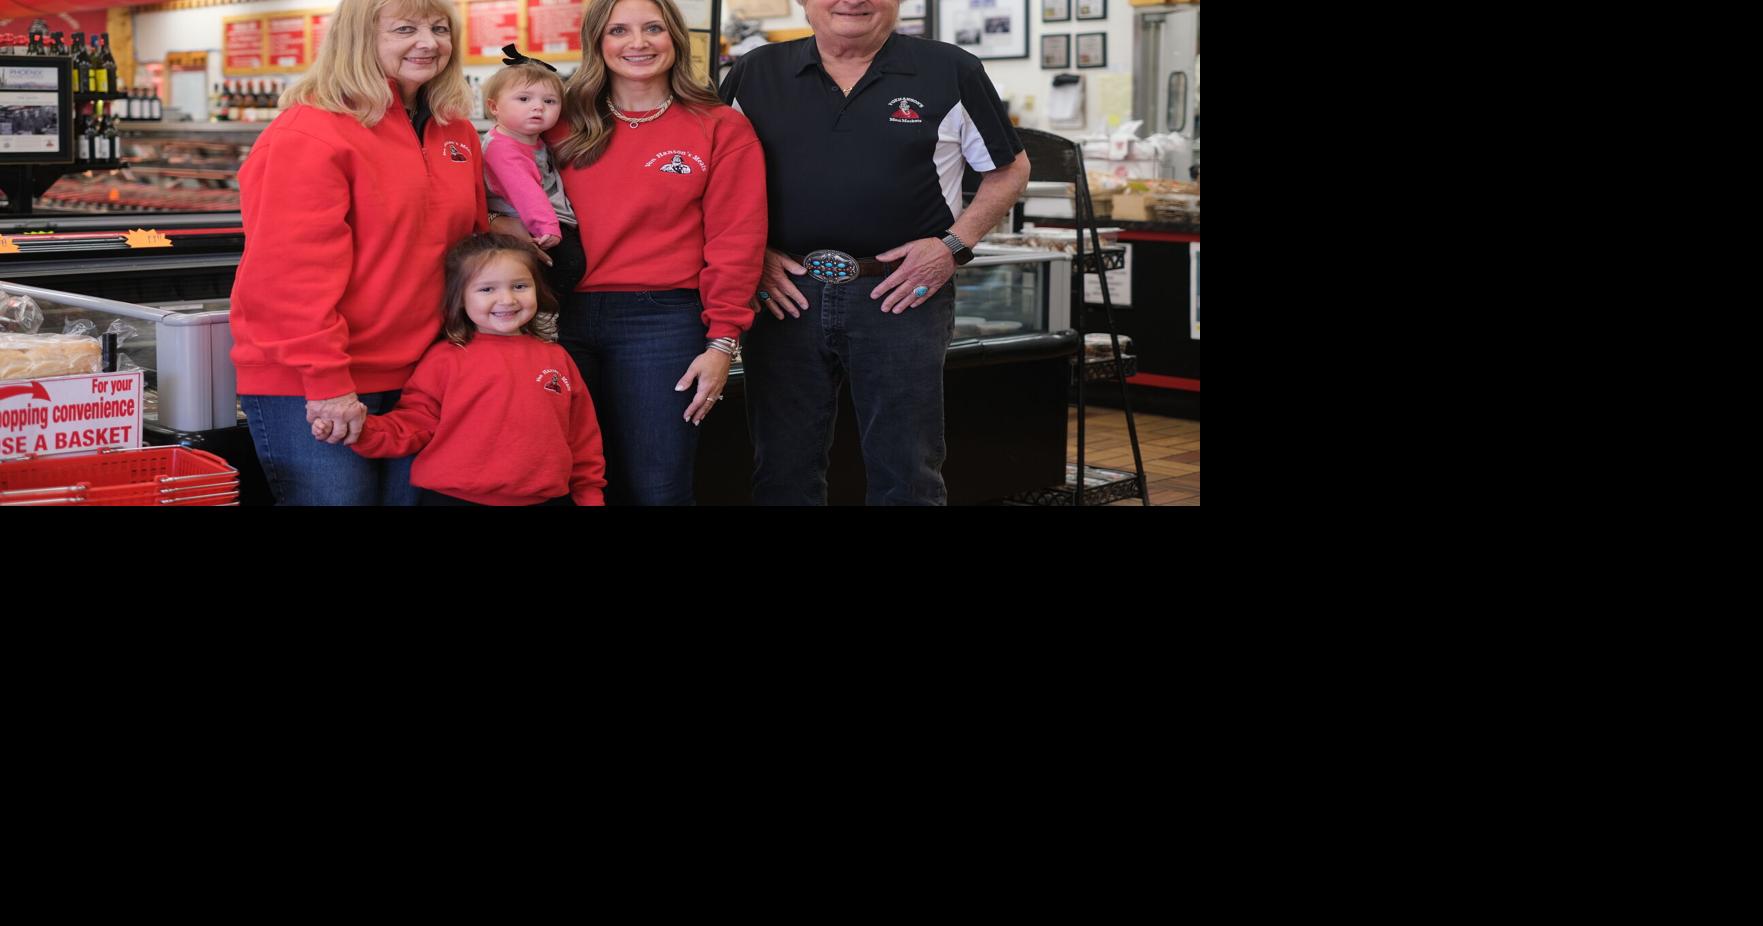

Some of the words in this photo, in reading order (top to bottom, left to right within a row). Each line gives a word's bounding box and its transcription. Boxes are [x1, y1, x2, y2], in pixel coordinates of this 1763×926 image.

[644, 158, 657, 167] Von
[655, 150, 692, 158] Hanson's
[692, 154, 707, 172] Meats
[92, 378, 109, 394] For
[110, 378, 134, 396] your
[0, 402, 49, 433] opping
[52, 396, 135, 424] convenience
[33, 433, 49, 452] A
[54, 425, 133, 450] BASKET
